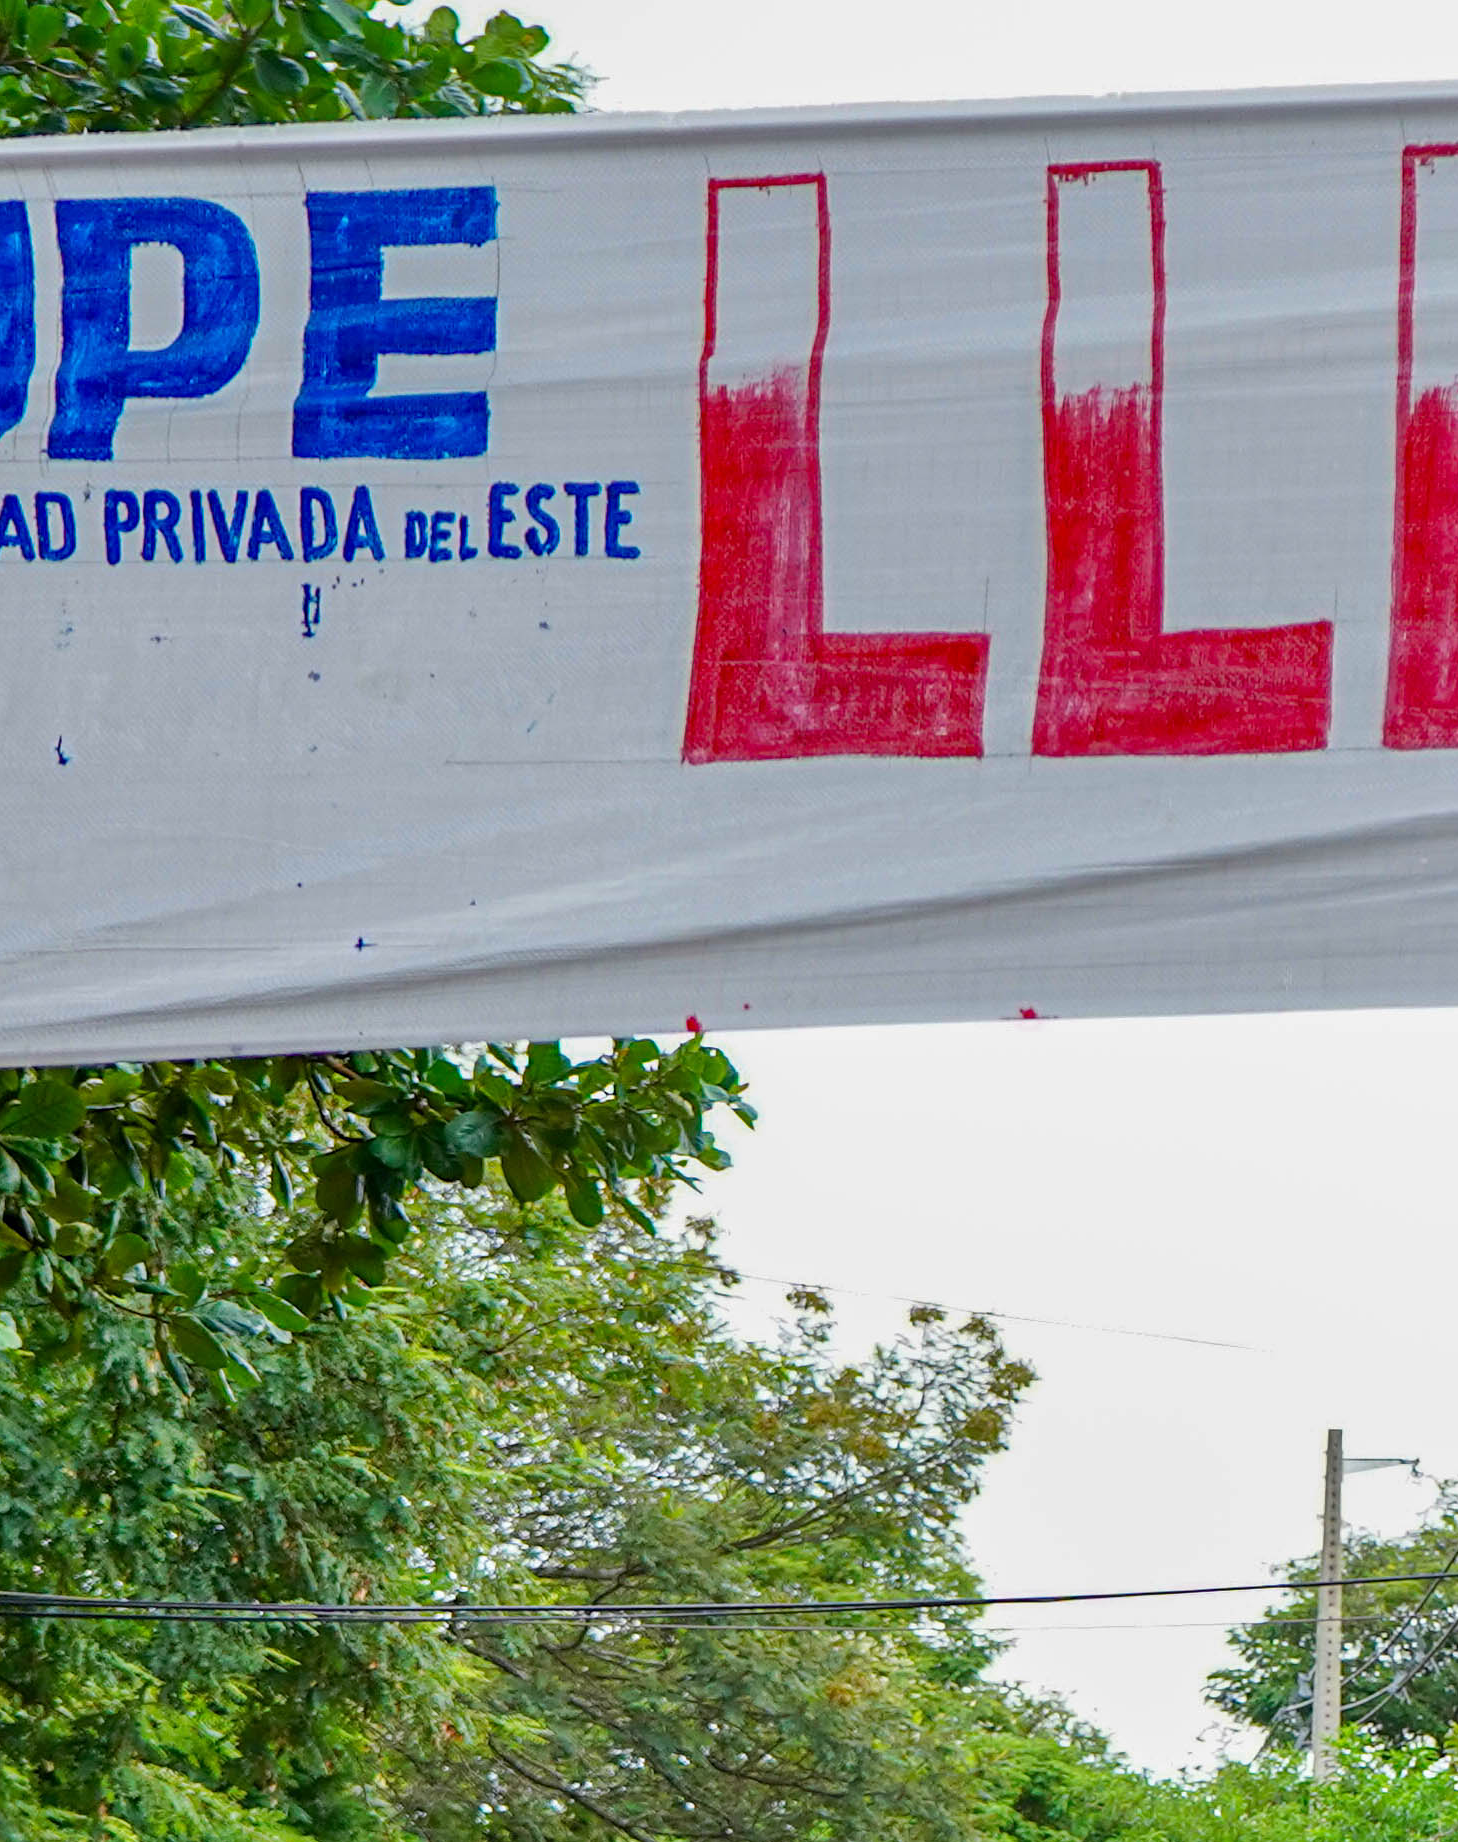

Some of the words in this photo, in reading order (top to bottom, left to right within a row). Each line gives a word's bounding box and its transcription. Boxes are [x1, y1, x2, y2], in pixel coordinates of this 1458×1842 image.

[104, 484, 387, 565] PRIVADA
[405, 509, 479, 563] DEL
[486, 480, 643, 561] ESTE
